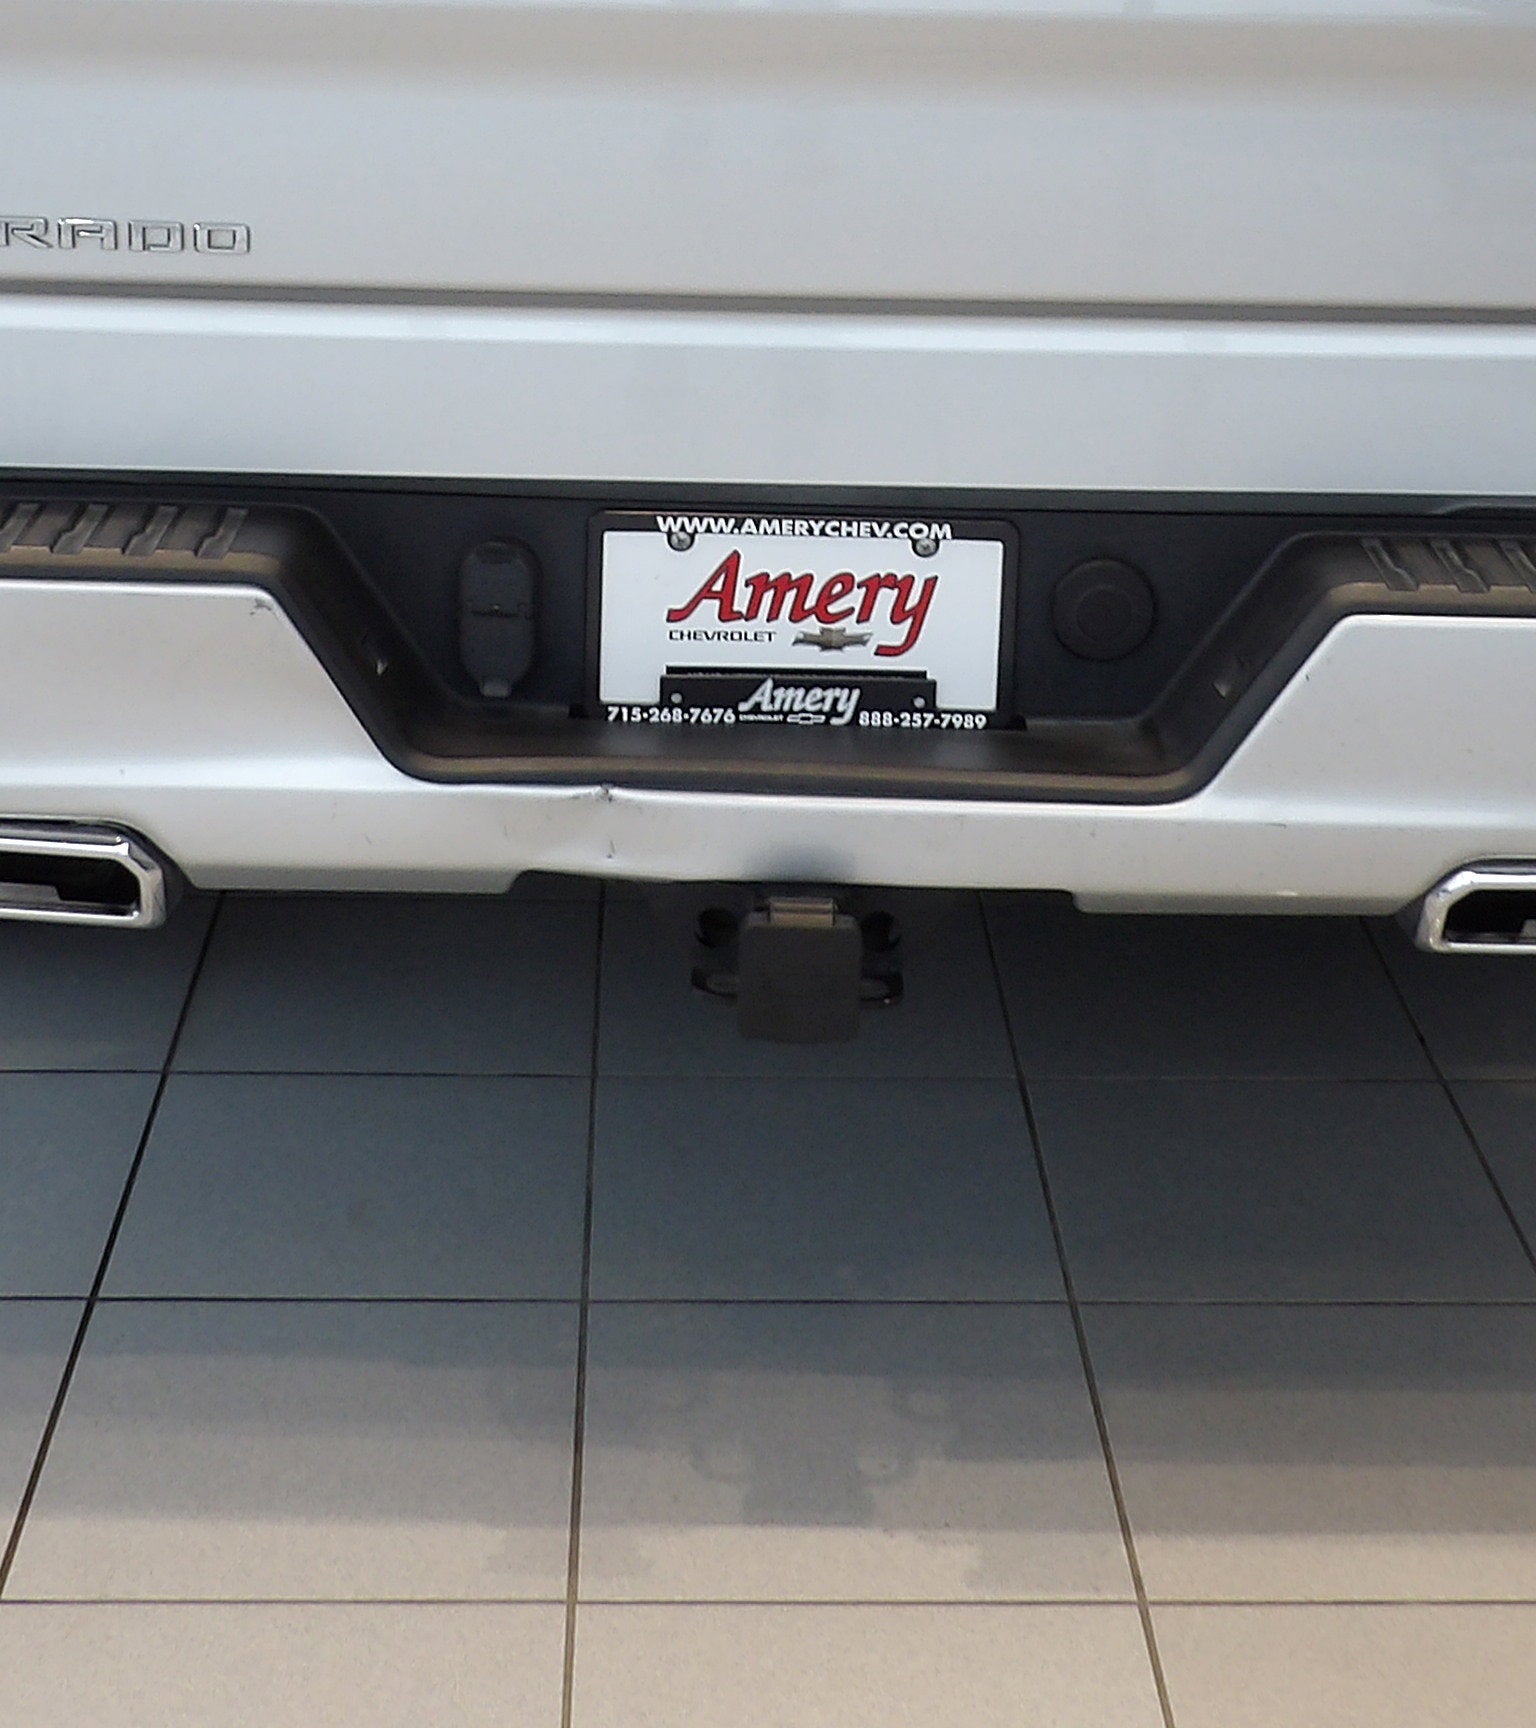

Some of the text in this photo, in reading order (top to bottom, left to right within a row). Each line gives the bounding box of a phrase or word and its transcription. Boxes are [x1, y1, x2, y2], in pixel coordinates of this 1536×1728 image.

[656, 515, 953, 540] WWW.AMERYCHEV.COM
[666, 549, 939, 657] Amery
[668, 629, 777, 643] CHEVROLET
[737, 675, 861, 726] Amery
